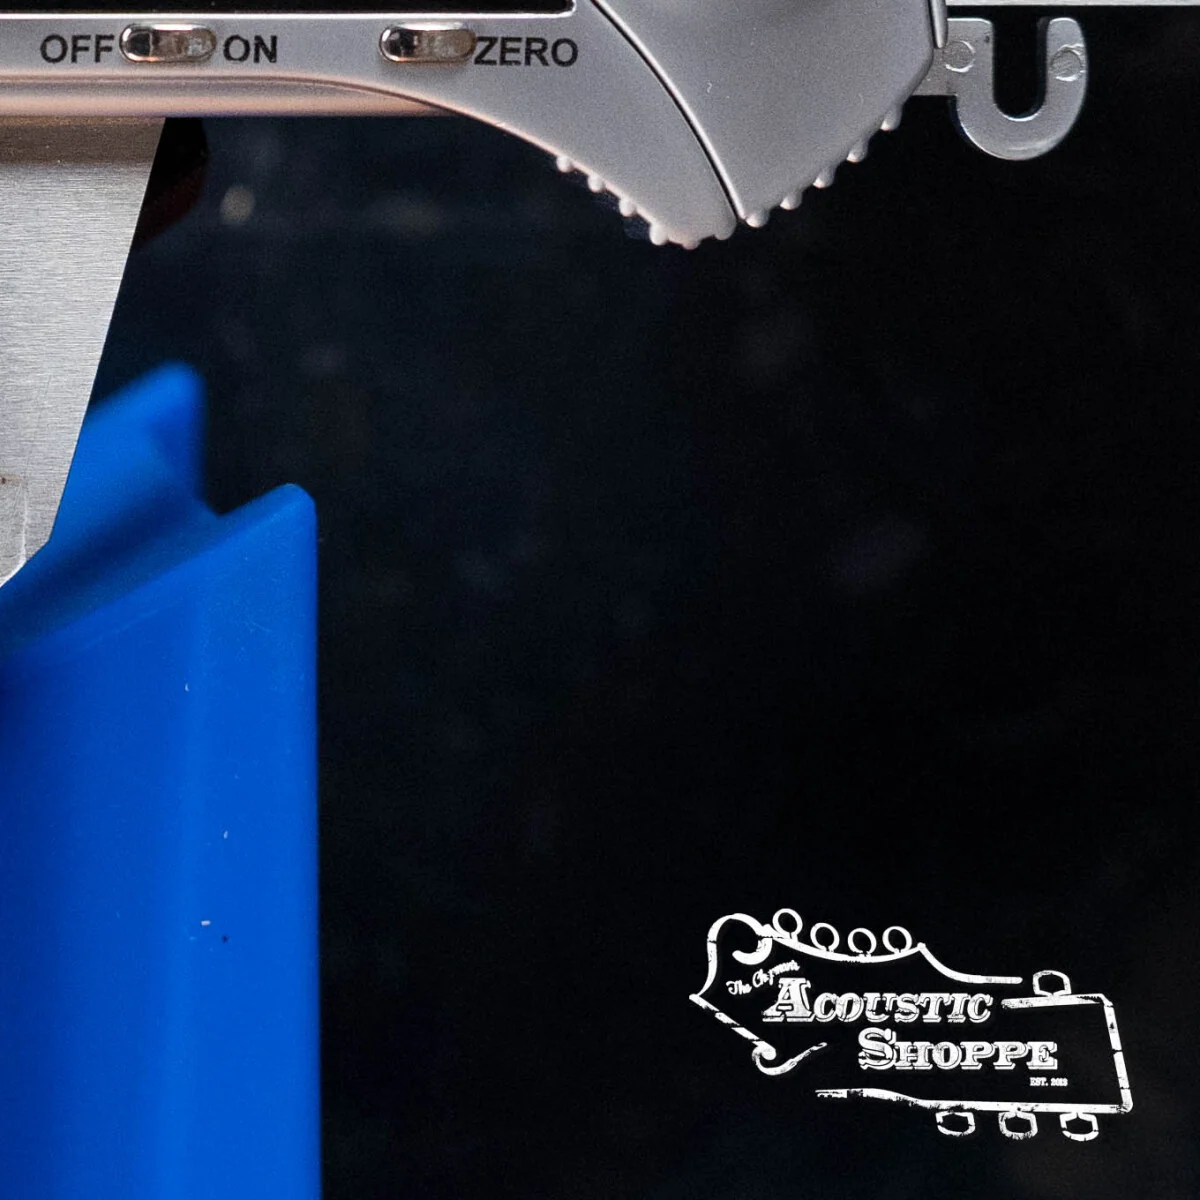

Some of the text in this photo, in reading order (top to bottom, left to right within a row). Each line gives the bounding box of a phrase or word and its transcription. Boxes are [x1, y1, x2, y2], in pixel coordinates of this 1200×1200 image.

[39, 34, 115, 64] OFF
[222, 34, 278, 64] ON
[472, 36, 579, 68] ZERO
